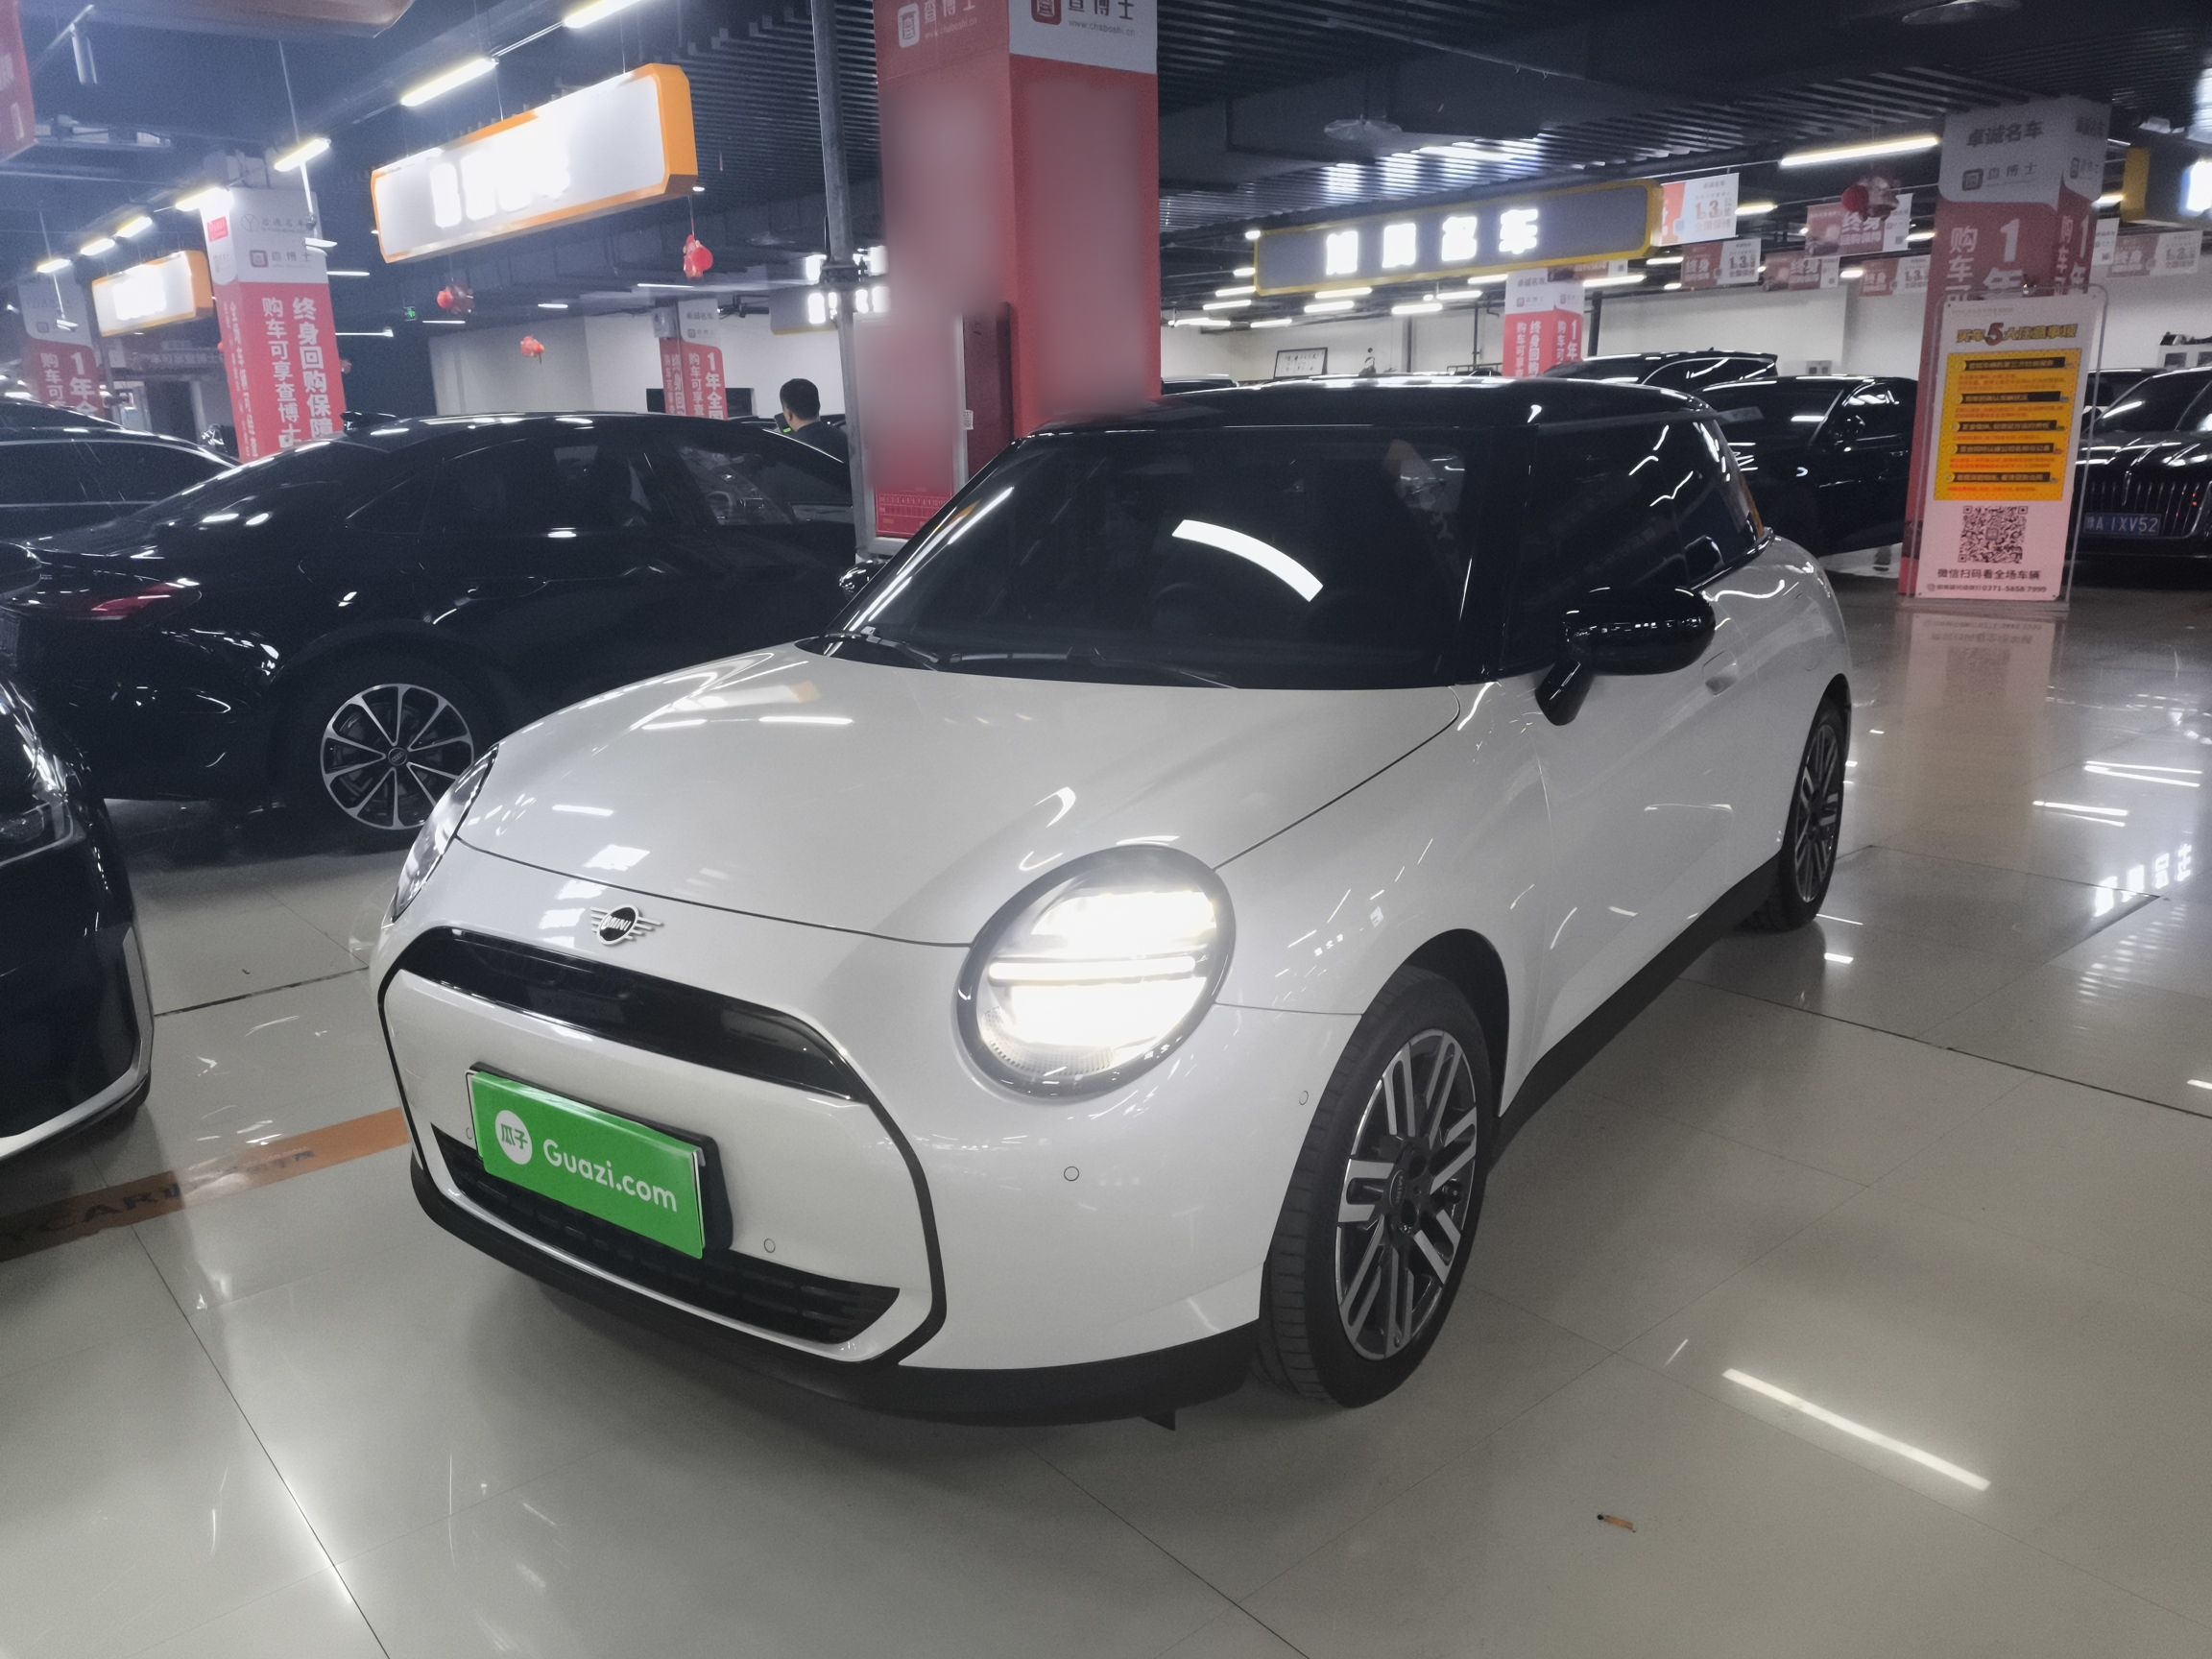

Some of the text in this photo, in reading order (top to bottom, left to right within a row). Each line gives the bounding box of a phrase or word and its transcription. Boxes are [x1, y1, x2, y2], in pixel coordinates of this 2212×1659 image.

[600, 914, 632, 931] MINI
[500, 1123, 528, 1150] 瓜子
[542, 1139, 678, 1214] Guazi.com
